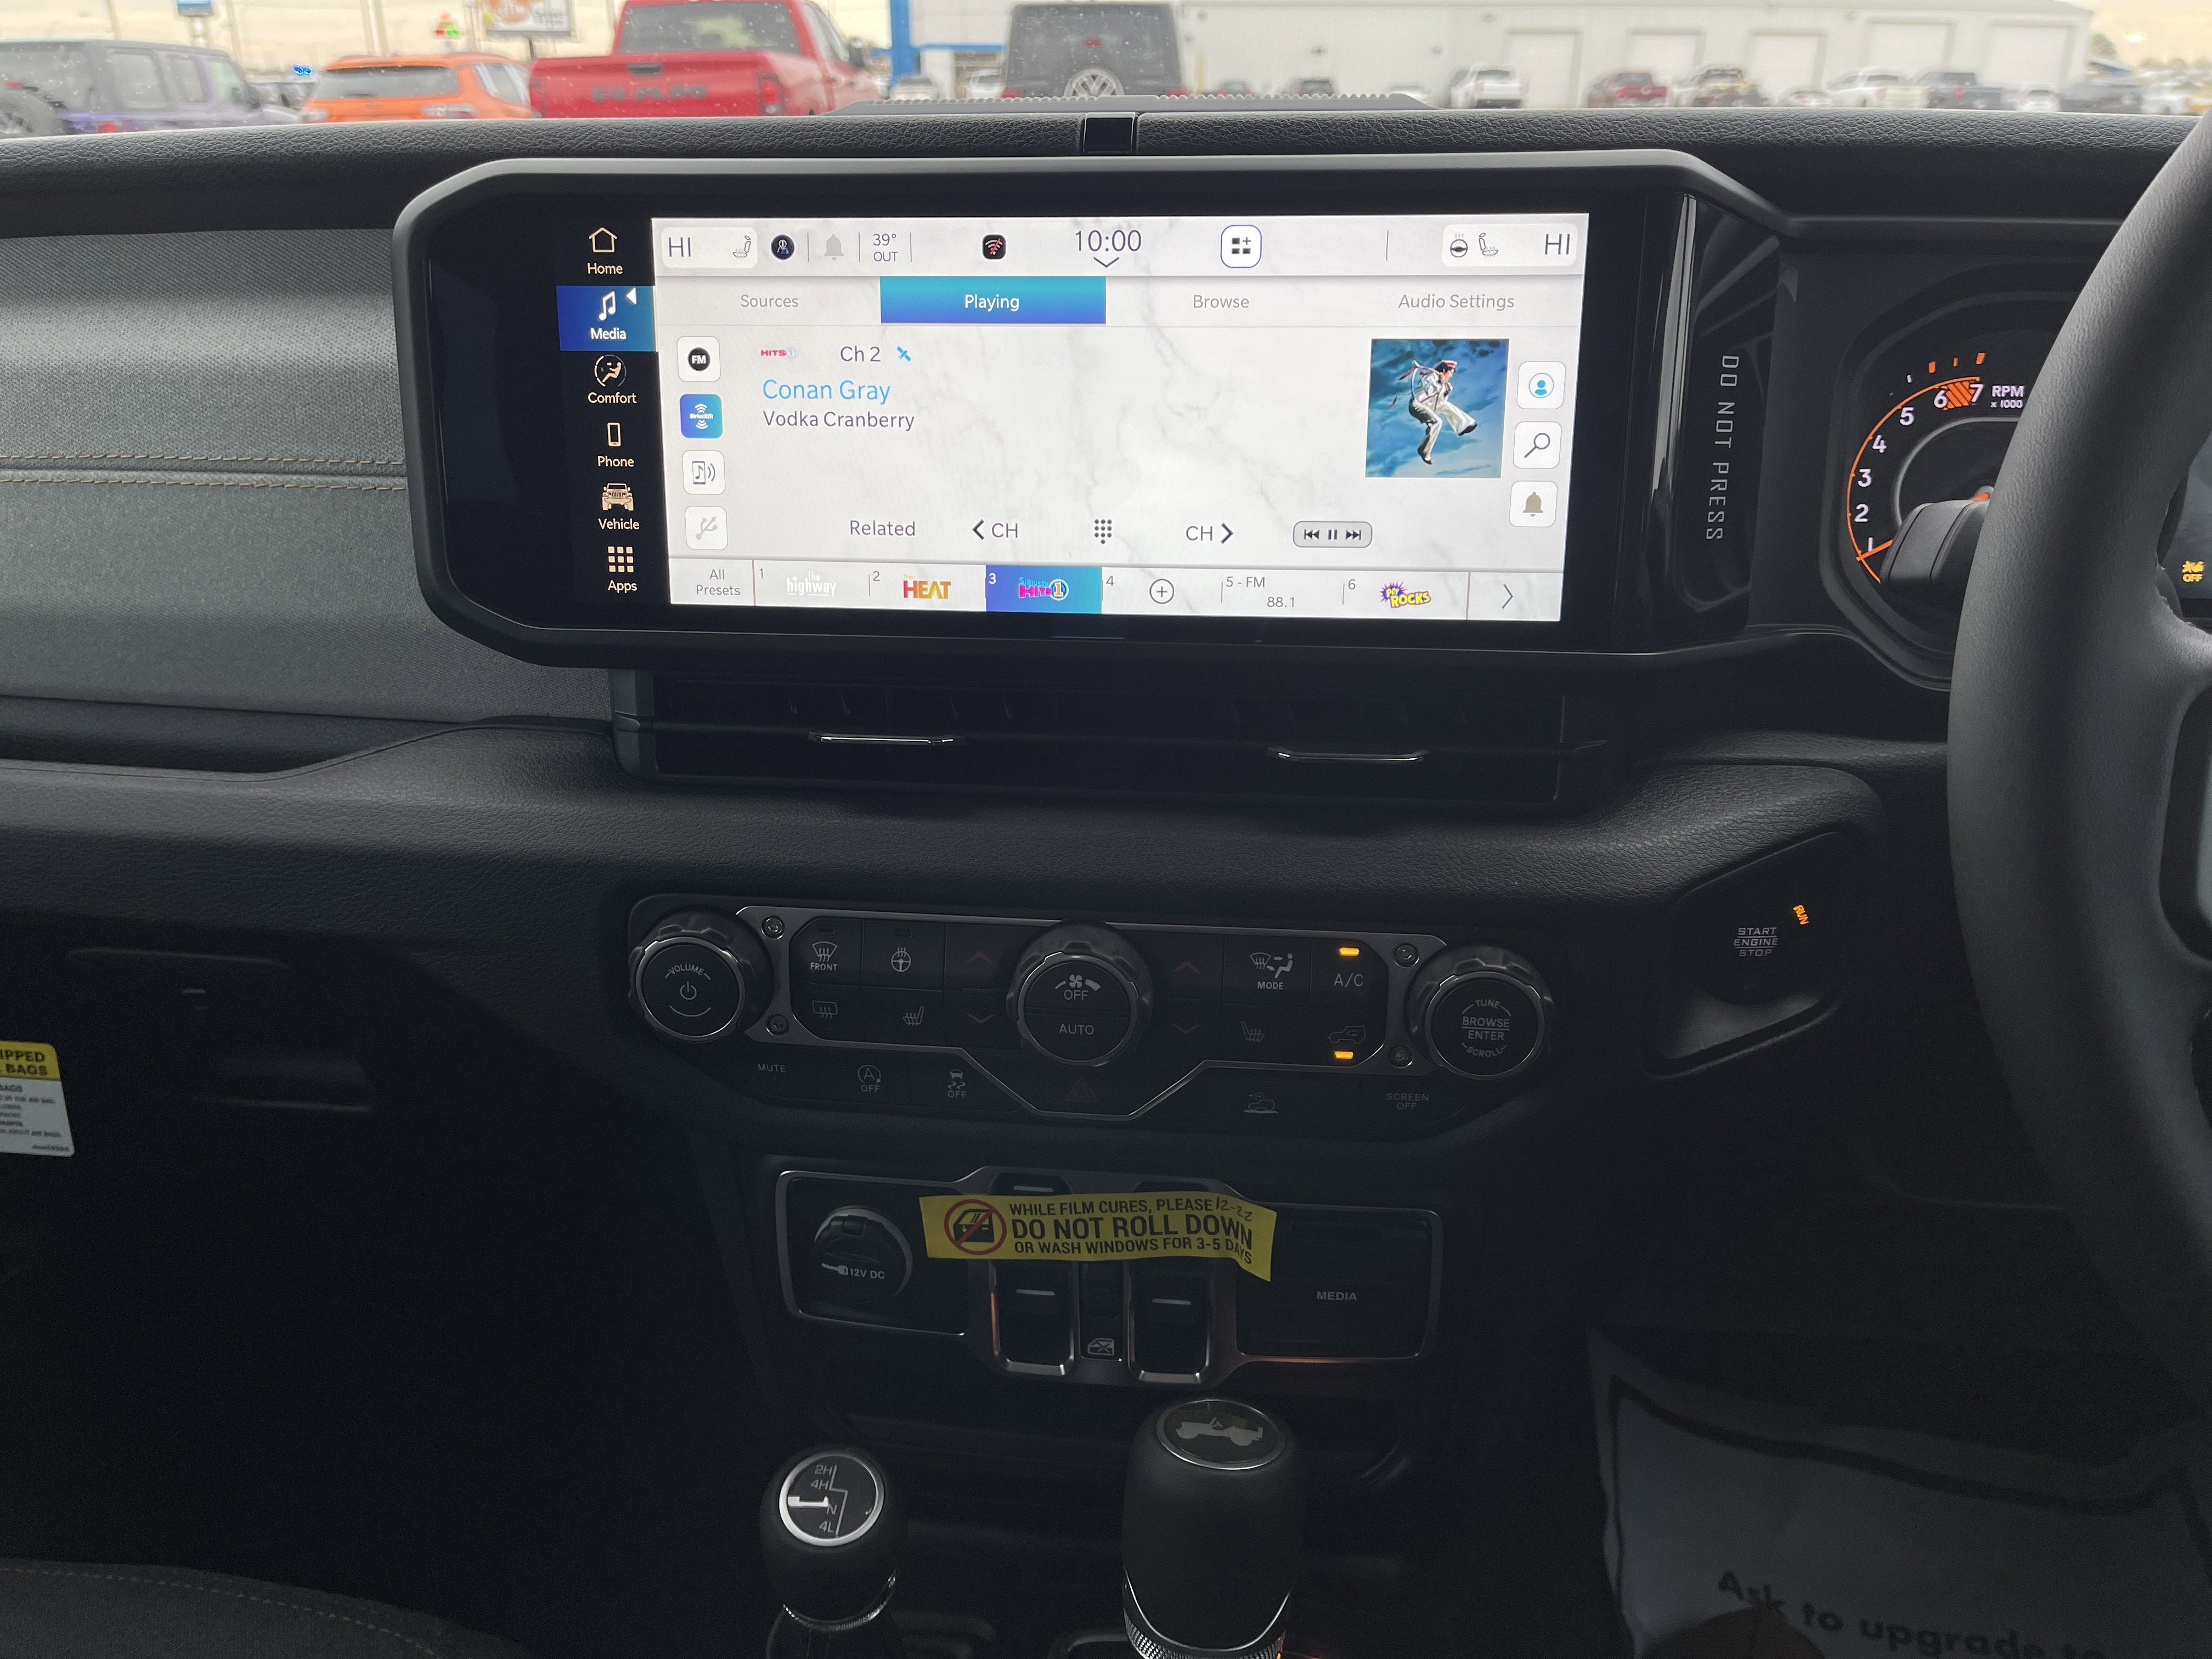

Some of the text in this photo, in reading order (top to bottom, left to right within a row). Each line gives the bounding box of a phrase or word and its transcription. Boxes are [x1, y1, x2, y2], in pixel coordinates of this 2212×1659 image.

[668, 236, 691, 257] HI
[1075, 229, 1142, 252] 10:00
[1544, 233, 1571, 255] HI
[873, 251, 898, 263] OUT
[587, 262, 623, 275] Home
[740, 294, 799, 308] Sources
[964, 294, 1020, 312] Playing
[1193, 294, 1250, 309] Browse
[1398, 294, 1515, 312] Audio Settings
[590, 328, 627, 341] Media
[691, 354, 707, 364] FM
[840, 346, 882, 362] Ch 2
[588, 391, 637, 404] Comfort
[763, 379, 891, 405] Conan Gray
[1970, 383, 1984, 403] 7
[1991, 385, 2024, 398] RPM
[1933, 390, 1948, 409] 6
[2000, 399, 2023, 409] 1000
[763, 410, 915, 432] Vodka Cranberry
[1899, 406, 1915, 426] 5
[1706, 355, 1740, 540] DO NOT PRESS
[1872, 434, 1887, 453] 4
[597, 456, 635, 468] Phone
[1858, 468, 1872, 487] 3
[1854, 503, 1870, 522] 2
[598, 518, 640, 531] Vehicle
[849, 520, 916, 537] Related
[991, 522, 1019, 539] CH
[1186, 525, 1214, 541] CH
[1867, 537, 1874, 552] 1
[709, 568, 725, 580] All
[759, 568, 764, 579] 1
[808, 571, 820, 582] the
[873, 571, 881, 582] 2
[988, 572, 996, 585] 3
[607, 580, 638, 594] Apps
[787, 576, 837, 597] highway
[1105, 575, 1115, 588] 4
[1225, 576, 1234, 588] 5
[1245, 577, 1266, 588] FM
[1347, 578, 1356, 591] 6
[696, 584, 741, 597] Presets
[902, 580, 952, 599] HEAT
[1266, 596, 1296, 608] 88.1
[1390, 591, 1431, 608] ROCKS
[1792, 904, 1809, 926] RUN
[1737, 927, 1778, 936] START
[1733, 938, 1779, 947] ENGINE
[1738, 949, 1773, 957] STOP
[668, 964, 706, 977] VOLUME
[810, 962, 838, 972] FRONT
[1257, 981, 1284, 991] MODE
[1333, 972, 1364, 989] A/C
[1063, 989, 1090, 1001] OFF
[1474, 998, 1502, 1010] TUNE
[1462, 1015, 1511, 1029] BROWSE
[1059, 1024, 1095, 1036] AUTO
[1467, 1030, 1505, 1041] ENTER
[1465, 1045, 1504, 1058] SCROLL
[5, 1063, 48, 1076] BAGS
[757, 1063, 787, 1073] MUTE
[860, 1083, 881, 1093] OFF
[947, 1089, 968, 1099] OFF
[1386, 1092, 1430, 1103] SCREEN
[1396, 1101, 1418, 1111] OFF
[1008, 1198, 1213, 1216] WHILE FILM CURES, PLEASE
[1012, 1214, 1252, 1250] DO NOT ROLL DOWN
[1014, 1238, 1252, 1265] OR WASH WINDOWS FOR 3-5 DAYS
[849, 1267, 886, 1280] 12V DC
[1316, 1291, 1358, 1301] MEDIA
[814, 1464, 833, 1476] 2H
[810, 1479, 829, 1490] 4H
[826, 1504, 837, 1515] N
[819, 1521, 834, 1533] 4L
[1802, 1602, 1844, 1633] to
[1859, 1614, 2045, 1659] upgrade
